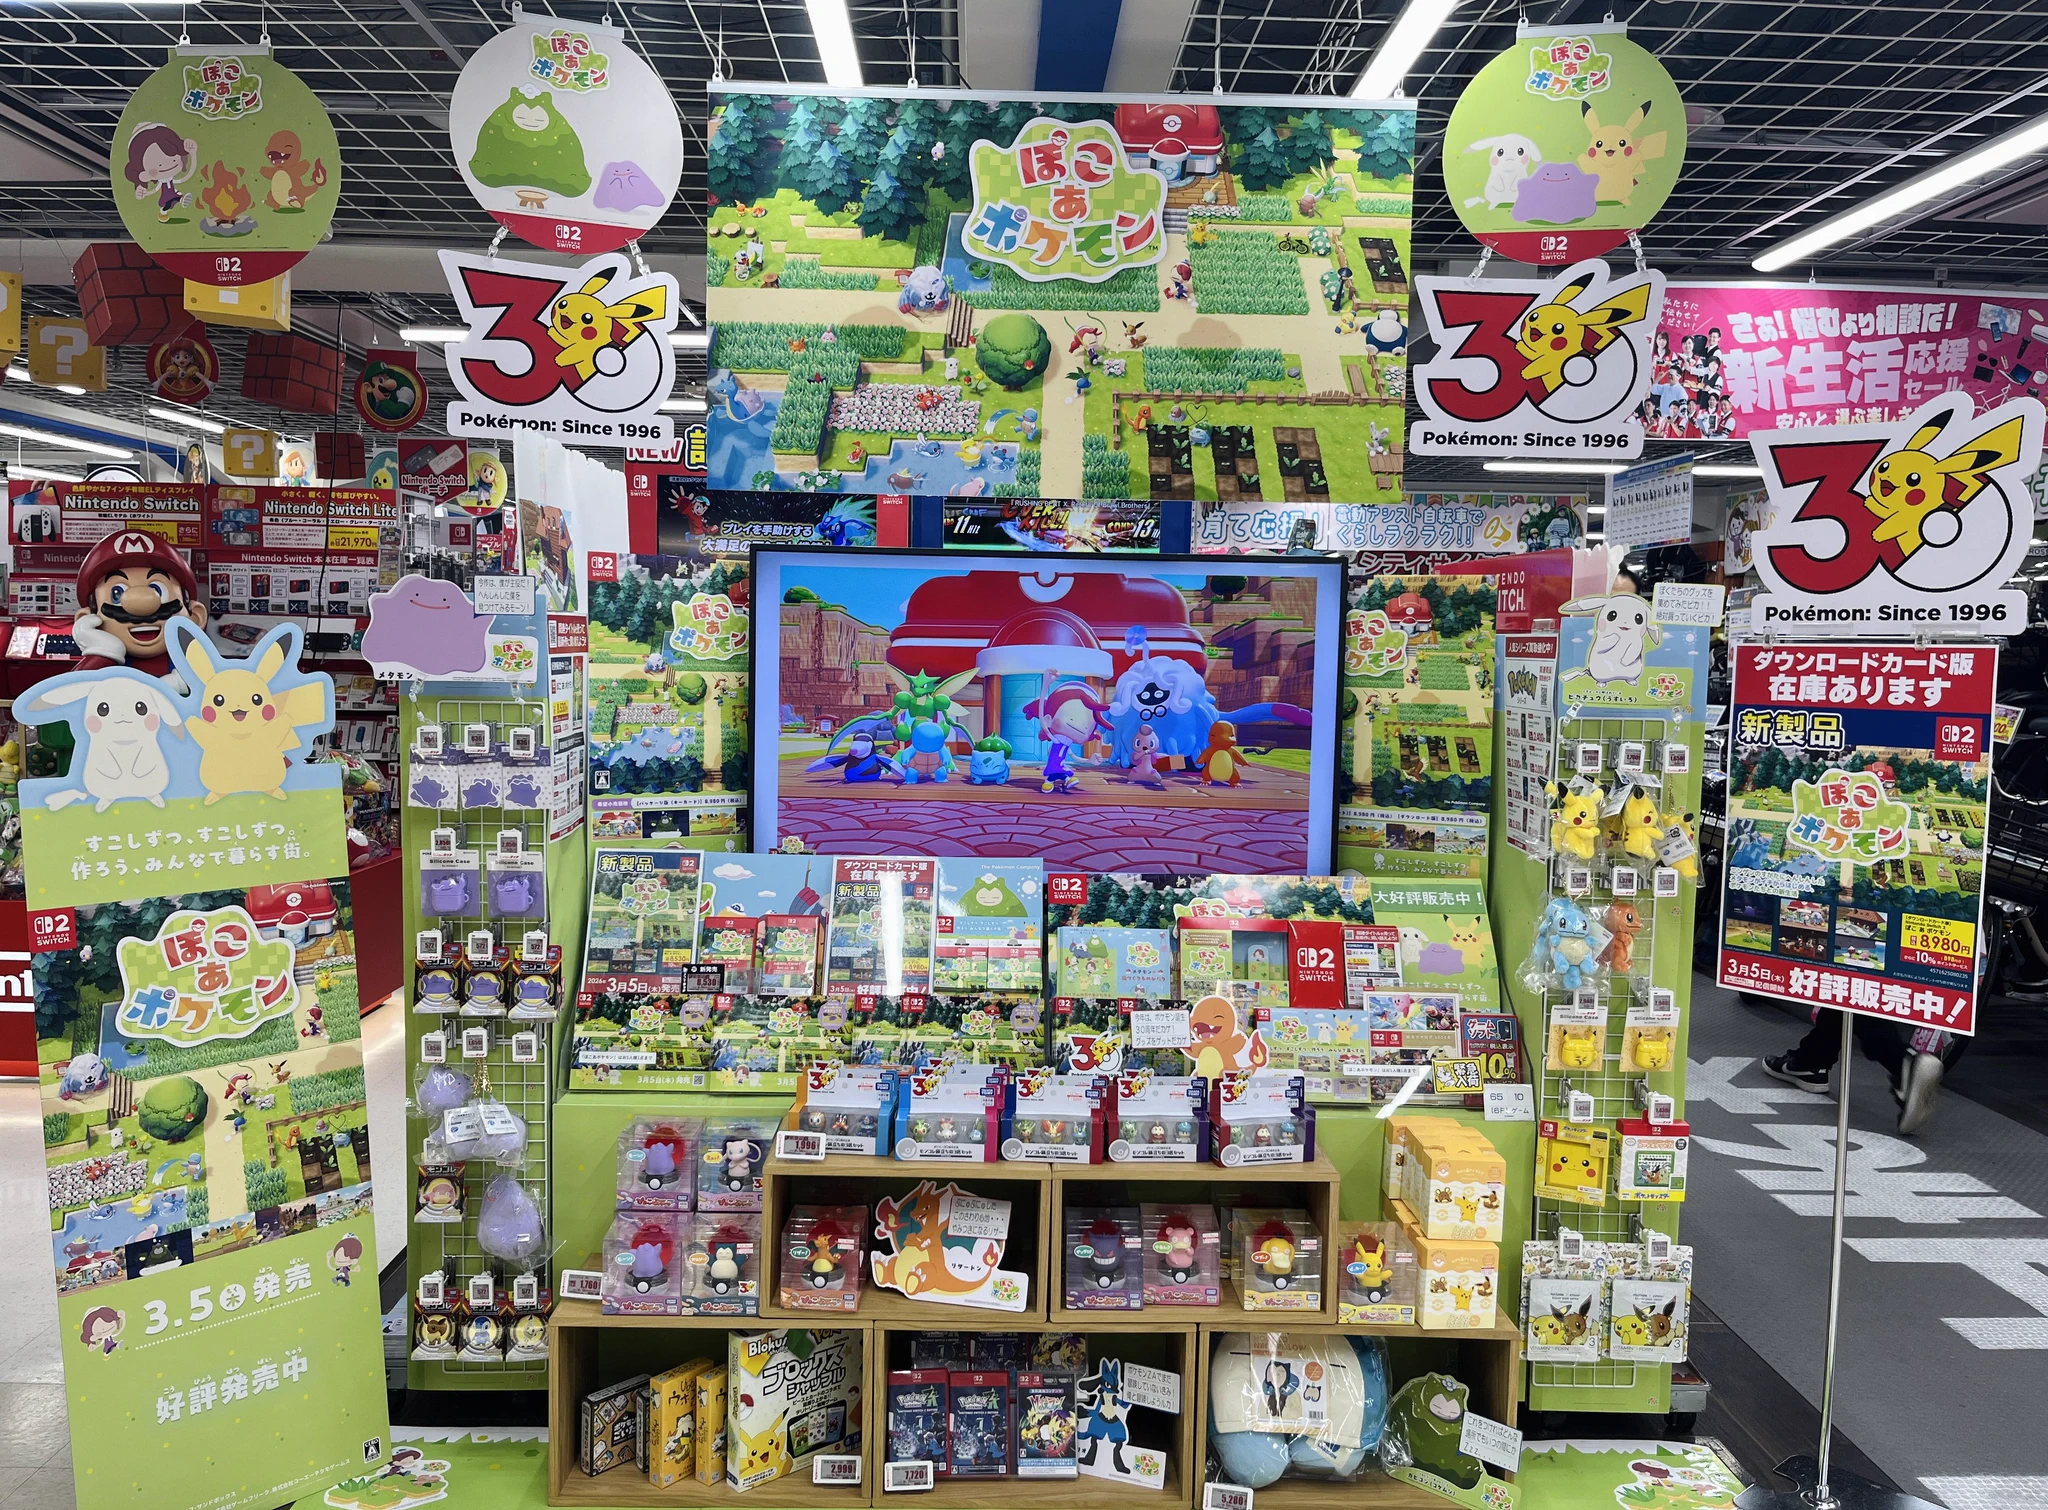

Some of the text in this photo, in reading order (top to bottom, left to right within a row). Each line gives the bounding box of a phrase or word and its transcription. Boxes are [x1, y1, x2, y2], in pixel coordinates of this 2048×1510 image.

[549, 32, 588, 58] ぽこ
[1550, 42, 1590, 63] ぽこ
[203, 61, 240, 82] ぽこ
[531, 57, 609, 89] ポケモン
[1530, 69, 1608, 94] ポケモン
[186, 90, 257, 112] ポケモン
[1019, 131, 1115, 188] ぽこ
[1053, 185, 1090, 221] あ
[975, 205, 1156, 262] ポケモン
[1904, 337, 1970, 376] 応援
[1722, 338, 1904, 413] 新生活
[460, 413, 661, 438] Pokémon: Since 1996
[1422, 431, 1629, 449] Pokémon: Since 1996
[401, 475, 465, 486] Nintendo Switch
[419, 486, 447, 496] ポーチ
[64, 496, 199, 511] Nintendo Switch
[264, 501, 397, 518] Nintendo Switch Lite
[1335, 505, 1485, 526] 電動アシスト自転車で
[723, 524, 813, 536] プレイを手助けする
[1336, 525, 1474, 548] くらしラクラク!!
[242, 554, 282, 562] Nintendo
[284, 555, 312, 563] Switch
[692, 597, 730, 620] ぽこ
[1765, 604, 2007, 623] Pokémon: Since 1996
[675, 627, 748, 653] ポケモン
[1753, 651, 1974, 676] ダウンロードカード版
[378, 671, 413, 680] メタモン
[1769, 675, 1952, 706] 在庫あります
[1739, 711, 1843, 747] 新製品
[1821, 777, 1878, 808] ぽこ
[1839, 808, 1861, 828] あ
[85, 822, 295, 852] すこしずつ、すこしずつ。
[1795, 814, 1905, 855] ポケモン
[71, 842, 310, 881] 作ろう、みんなで暮らす街。
[600, 856, 652, 872] 新製品
[844, 862, 928, 870] ダウンロードカード版
[838, 885, 880, 898] 新製品
[1374, 891, 1483, 906] 大好評販売中!
[54, 914, 70, 932] 2
[37, 937, 70, 946] SWITCH
[163, 918, 250, 968] ぽこ
[1920, 935, 1971, 954] 8,980円
[1916, 951, 1936, 965] 10%
[198, 962, 229, 991] あ
[1727, 959, 1785, 983] 3月5日(木)
[1755, 980, 1784, 993] 配信開始
[1789, 967, 1967, 1024] 好評販売中!
[126, 972, 289, 1031] ポケモン
[1467, 1019, 1496, 1029] ゲーム
[749, 1337, 787, 1357] Blokus
[763, 1343, 845, 1396] ブロックス
[156, 1354, 309, 1425] 好評発売中
